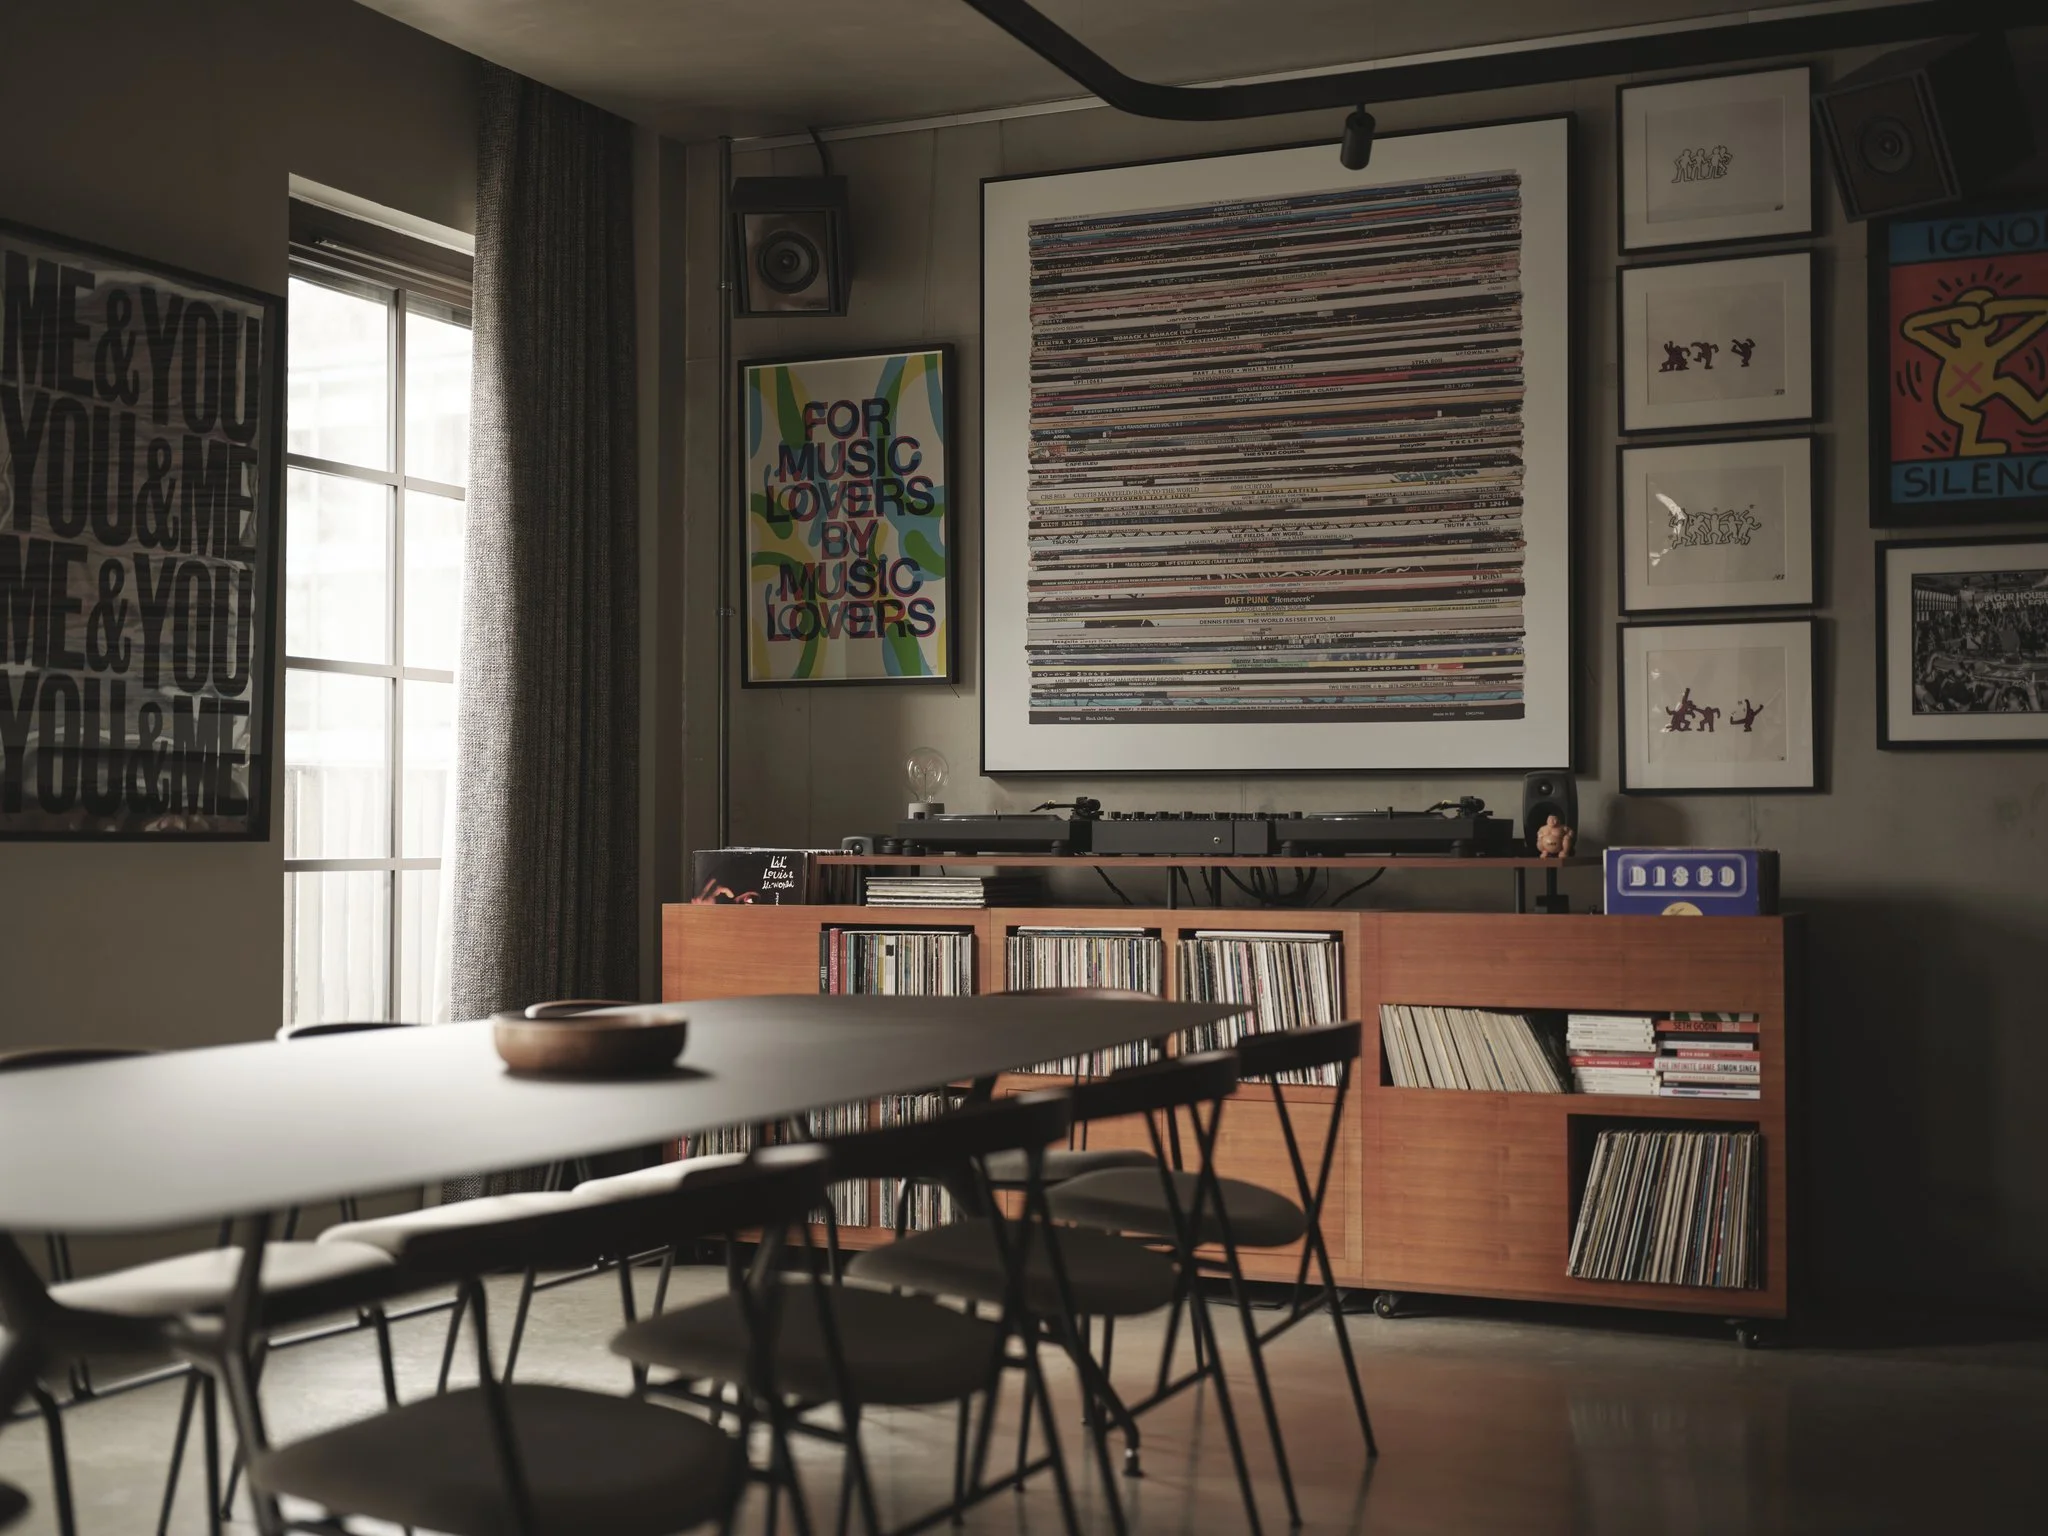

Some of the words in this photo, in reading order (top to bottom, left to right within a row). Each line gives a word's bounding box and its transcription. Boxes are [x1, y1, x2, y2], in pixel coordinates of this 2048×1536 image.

[1927, 215, 2048, 254] IGNO
[803, 398, 891, 441] FOR
[779, 435, 922, 483] MUSIC
[766, 475, 935, 523] LOVERS
[821, 518, 878, 560] BY
[779, 556, 923, 602] MUSIC
[1994, 592, 2014, 601] OUR
[767, 596, 936, 642] LOVERS
[1224, 597, 1245, 605] DAFT
[1246, 596, 1269, 604] PUNK
[1271, 595, 1315, 603] "Homework"
[1629, 865, 1736, 887] DISCO
[1673, 1021, 1692, 1030] SETH
[1693, 1021, 1718, 1031] GODIN
[1658, 1061, 1669, 1071] THE
[1671, 1062, 1698, 1071] INFINITE
[1699, 1062, 1716, 1072] GAME
[1717, 1063, 1737, 1072] SIMON
[1739, 1064, 1757, 1073] SINEK
